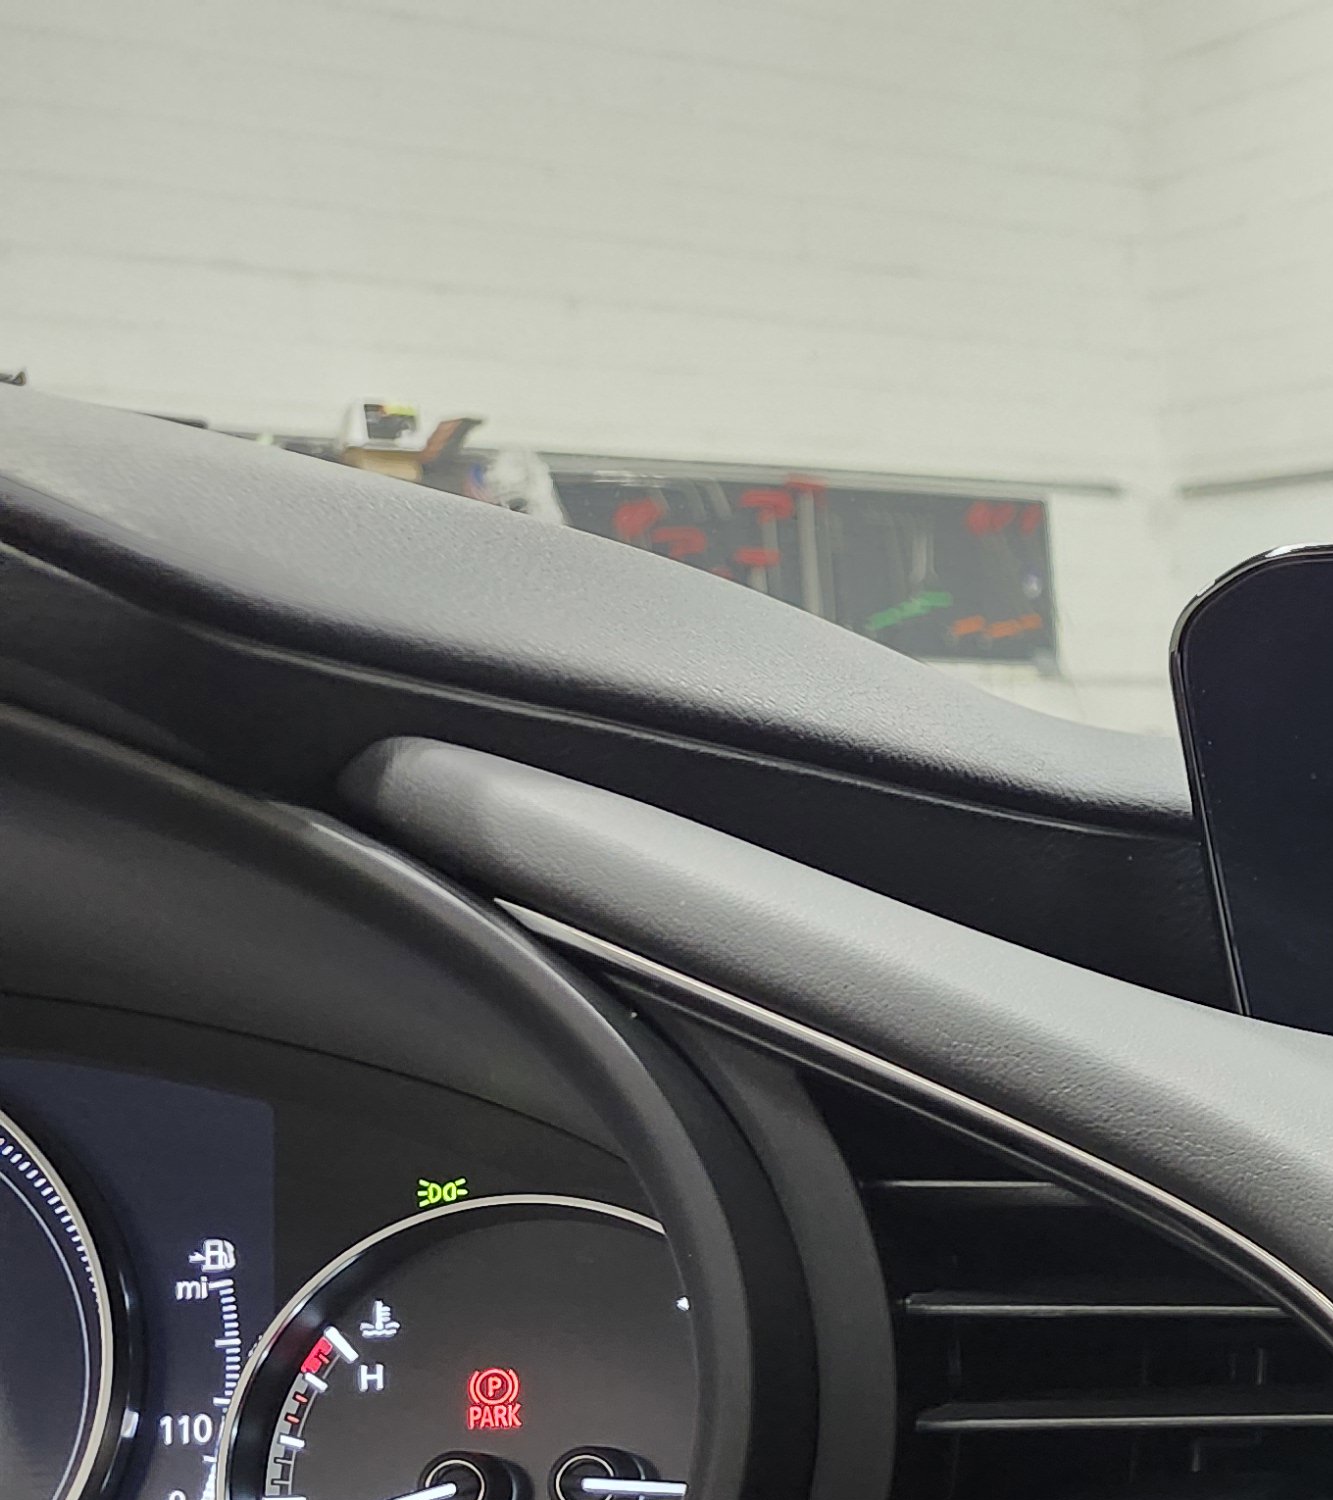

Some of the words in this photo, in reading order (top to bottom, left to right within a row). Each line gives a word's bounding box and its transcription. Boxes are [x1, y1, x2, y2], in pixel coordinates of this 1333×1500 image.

[175, 1275, 207, 1301] mi
[360, 1365, 384, 1392] H
[486, 1375, 503, 1399] P
[159, 1413, 212, 1446] 110
[467, 1404, 522, 1430] PARK
